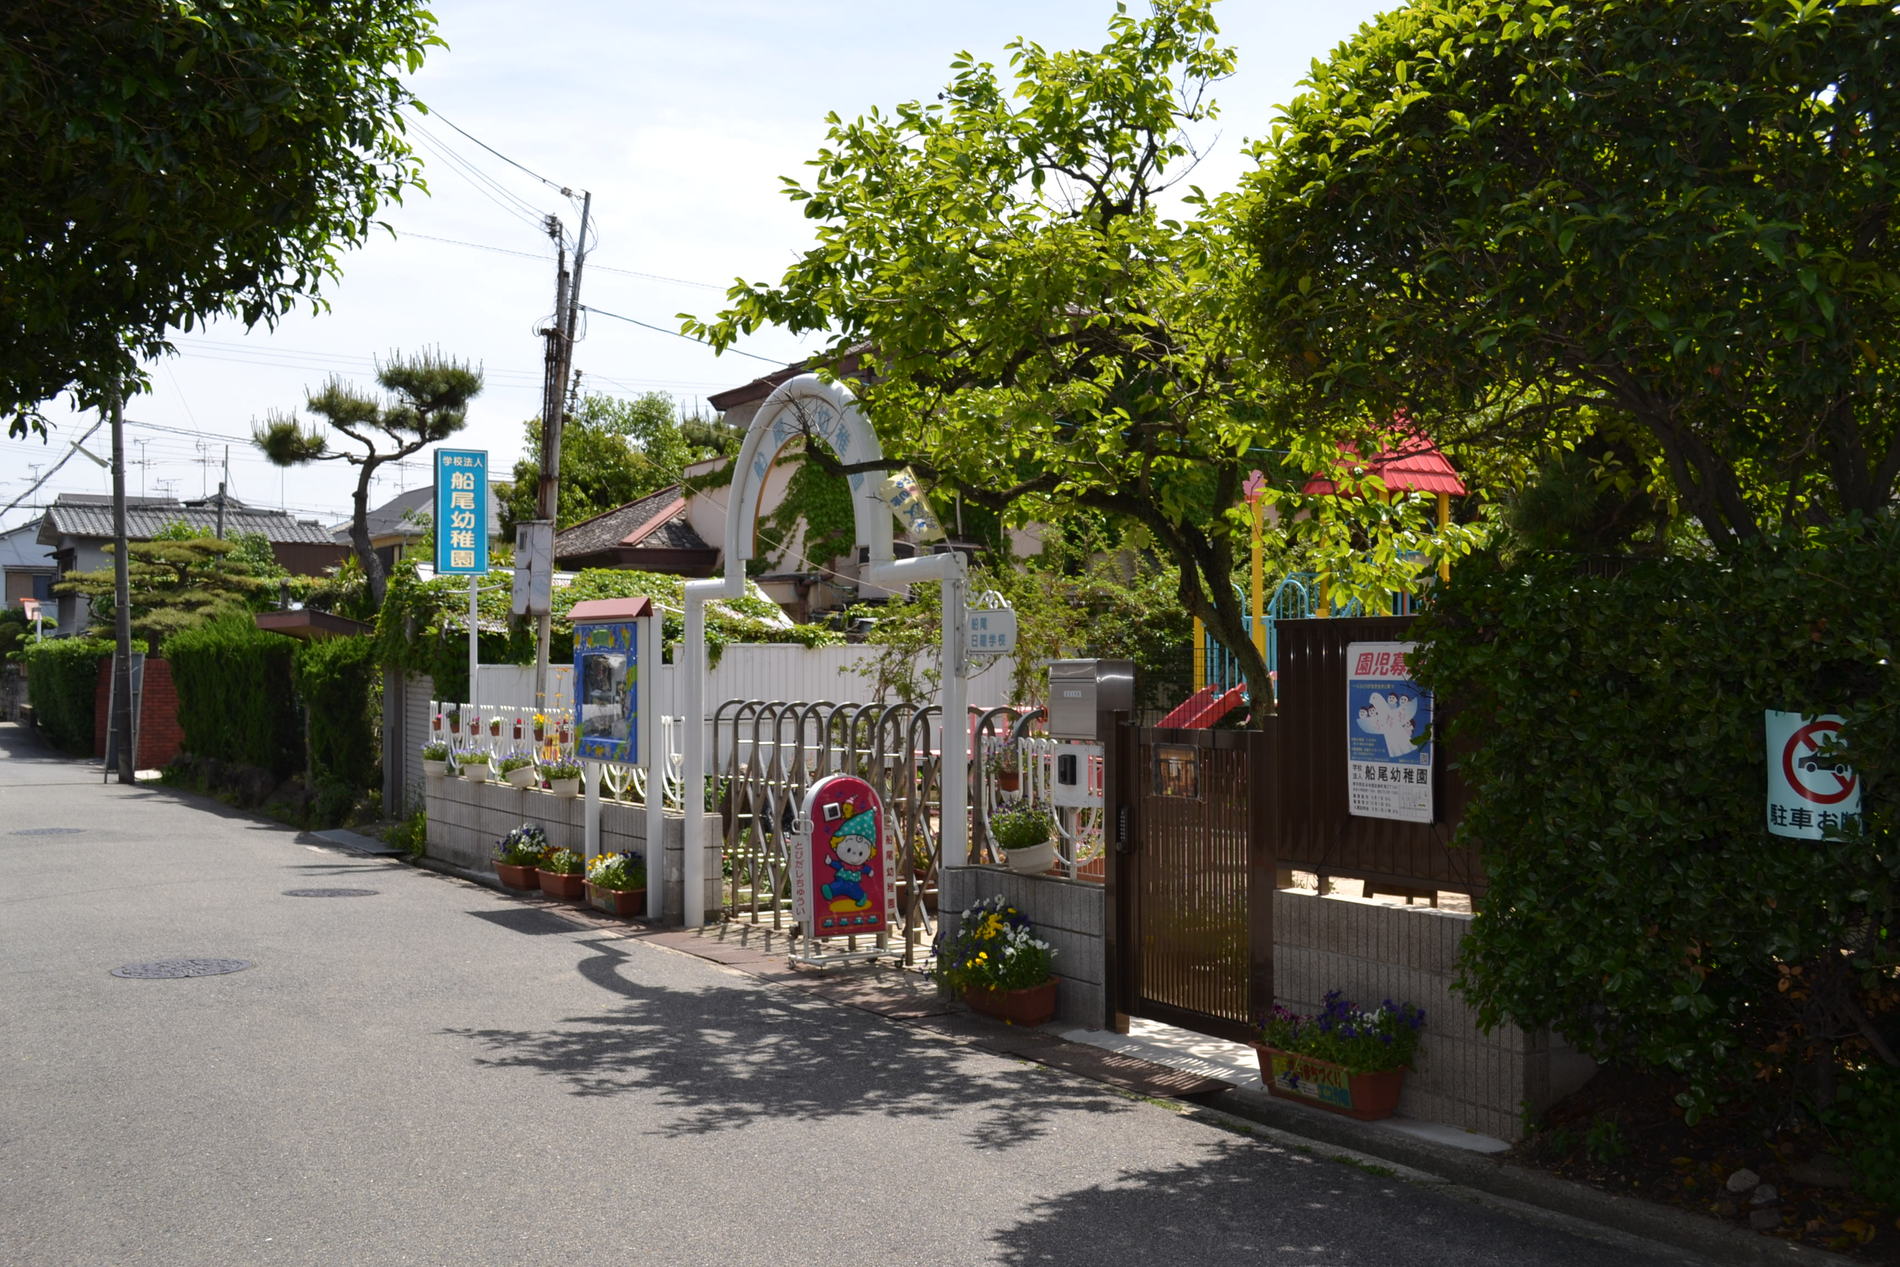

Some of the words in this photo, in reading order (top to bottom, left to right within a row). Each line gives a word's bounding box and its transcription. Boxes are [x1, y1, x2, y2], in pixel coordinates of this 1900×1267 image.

[442, 455, 484, 468] 学校法人
[450, 471, 476, 568] 船尾幼稚園
[1355, 651, 1424, 676] 園児募
[1365, 764, 1428, 785] 船尾幼稚園
